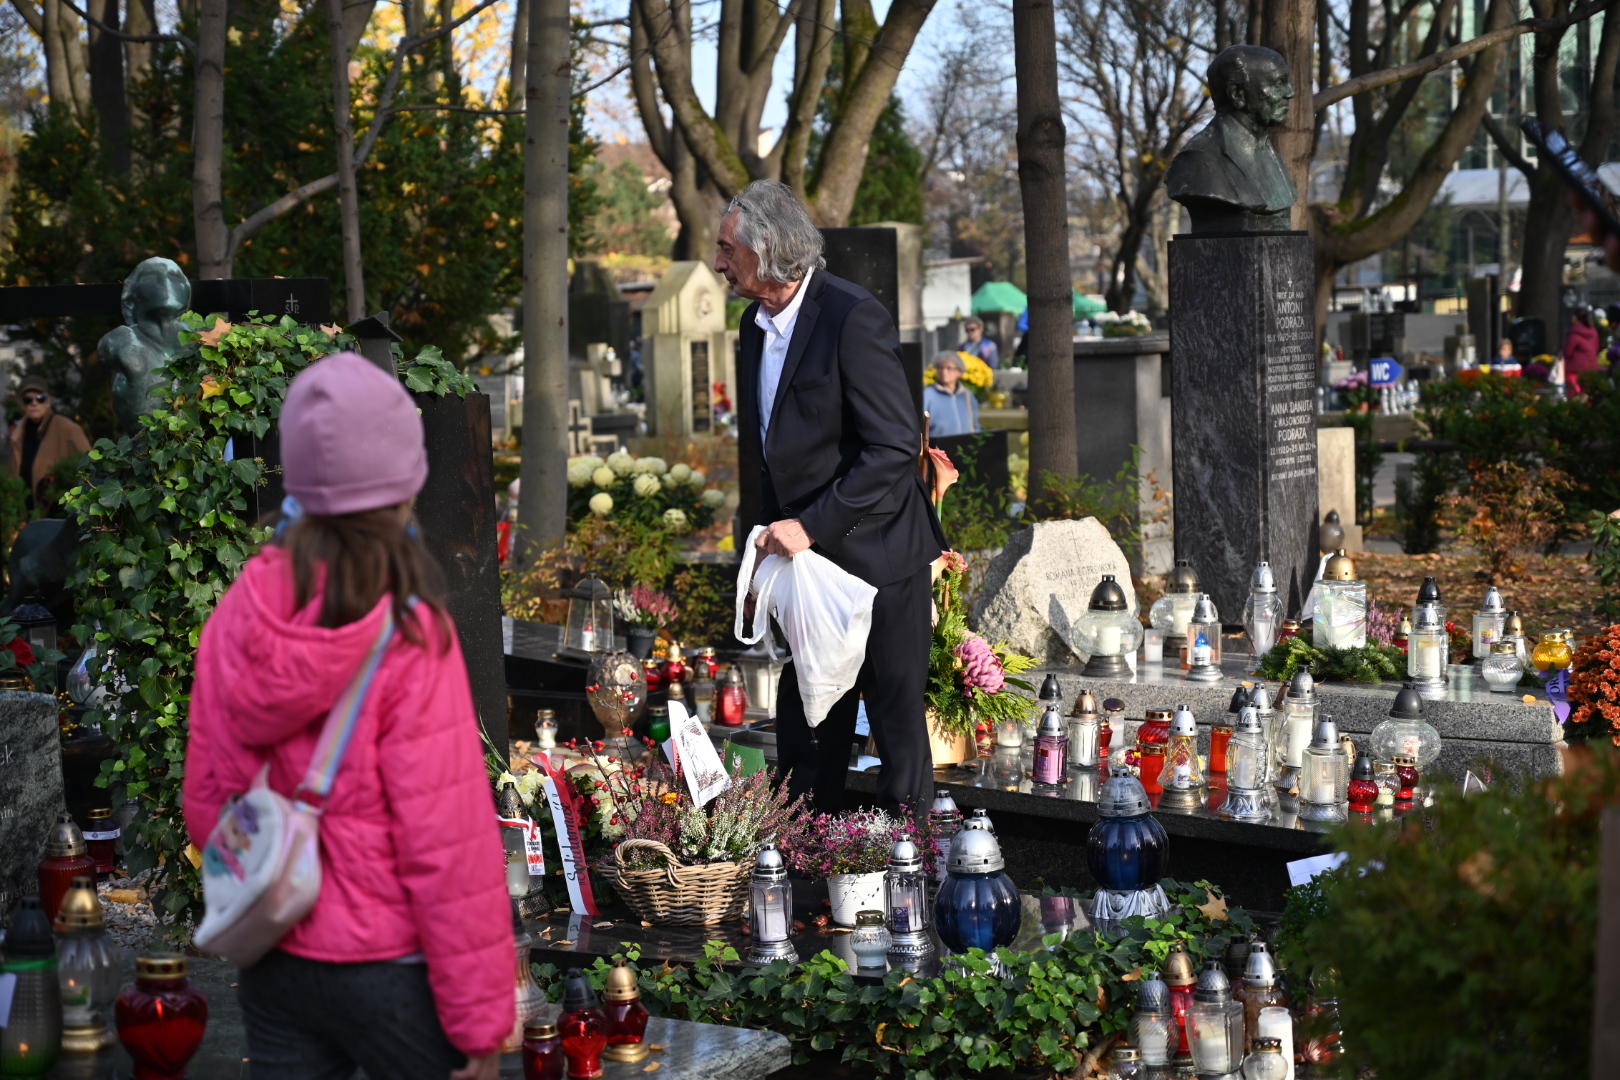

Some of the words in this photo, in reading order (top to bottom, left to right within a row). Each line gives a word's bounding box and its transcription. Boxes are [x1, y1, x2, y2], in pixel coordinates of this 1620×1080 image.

[1276, 302, 1303, 314] ANTONI
[1276, 316, 1305, 330] PODRAZA
[1280, 345, 1302, 354] HISTORYK
[1292, 353, 1314, 362] DYREKTOR
[1372, 362, 1390, 381] WC
[1271, 402, 1288, 416] ANNA
[1290, 400, 1314, 414] DANUTA
[1278, 427, 1308, 442] PODRAZA
[1045, 568, 1075, 581] ROMANA
